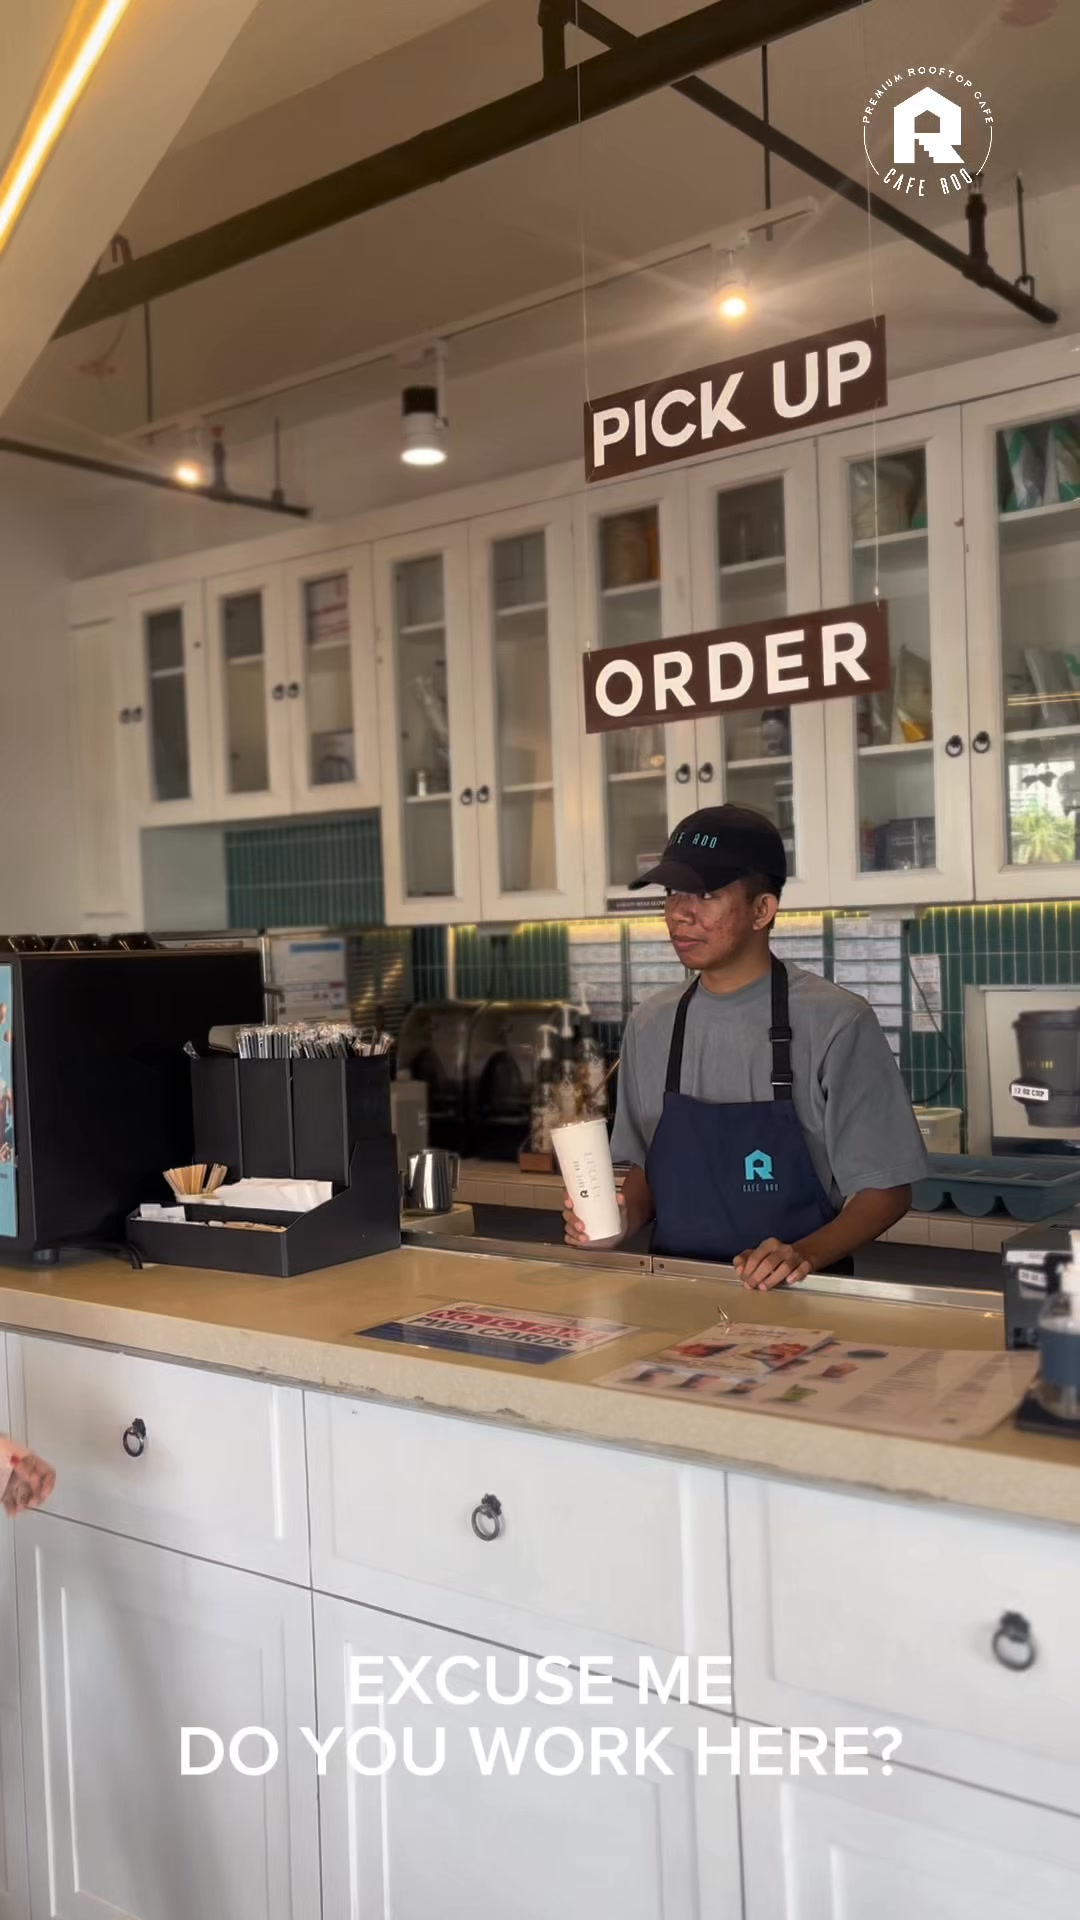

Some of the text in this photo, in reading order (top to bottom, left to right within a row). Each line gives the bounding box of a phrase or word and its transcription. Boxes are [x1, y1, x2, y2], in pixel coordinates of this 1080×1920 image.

[593, 340, 872, 468] PICK UP
[595, 621, 871, 718] ORDER
[407, 1317, 577, 1348] PWD CARDS
[429, 1310, 477, 1321] NO
[486, 1318, 521, 1328] TO
